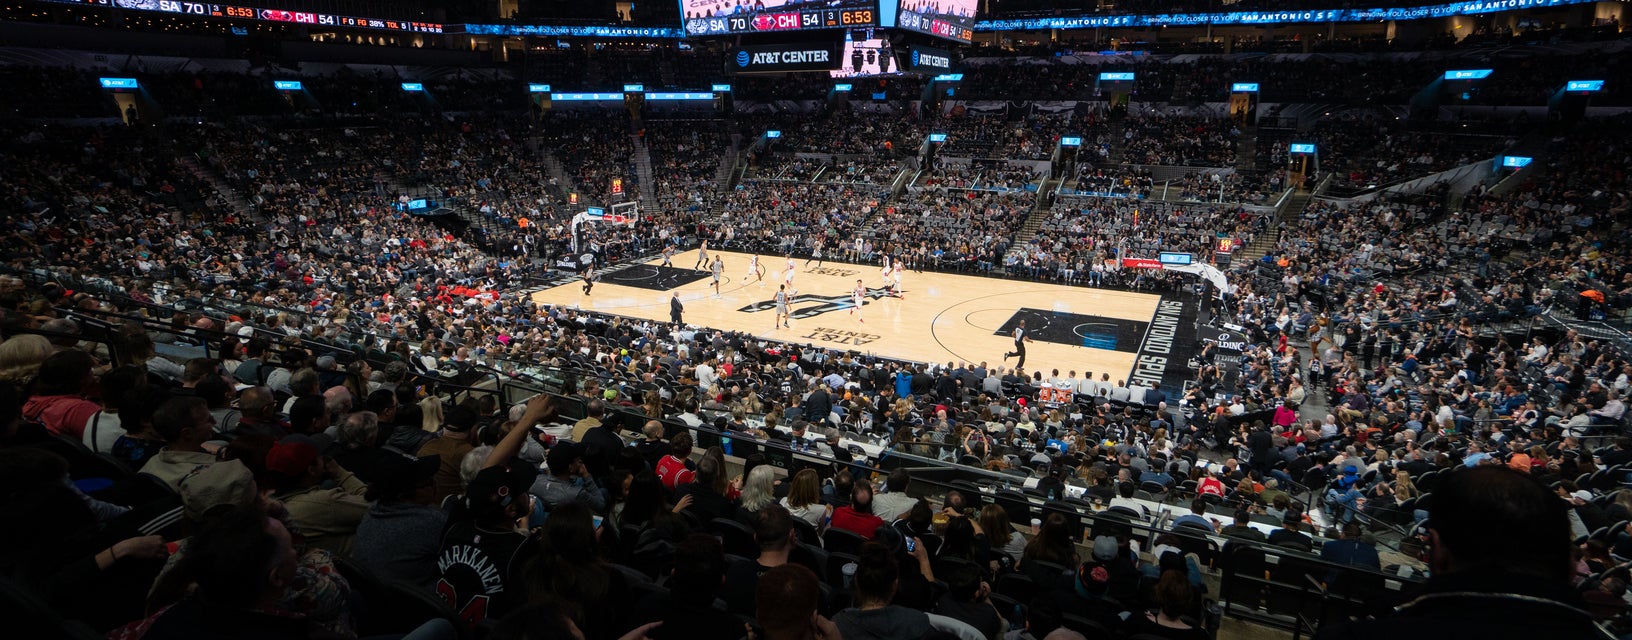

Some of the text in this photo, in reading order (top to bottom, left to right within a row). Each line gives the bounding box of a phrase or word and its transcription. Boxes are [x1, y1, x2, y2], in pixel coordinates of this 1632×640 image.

[160, 1, 204, 14] SA 70
[226, 6, 253, 17] 6:53
[295, 12, 334, 25] CHI 54
[710, 14, 818, 31] SA 70 CHI 54
[842, 11, 872, 24] 6:53
[912, 16, 956, 36] SA 70 CHI 54
[752, 50, 829, 64] AT&T CENTER
[919, 54, 949, 68] AT&T CENTER
[1158, 300, 1183, 316] SAN
[1144, 314, 1179, 354] ANTONIO
[437, 545, 504, 594] MARKKANEN
